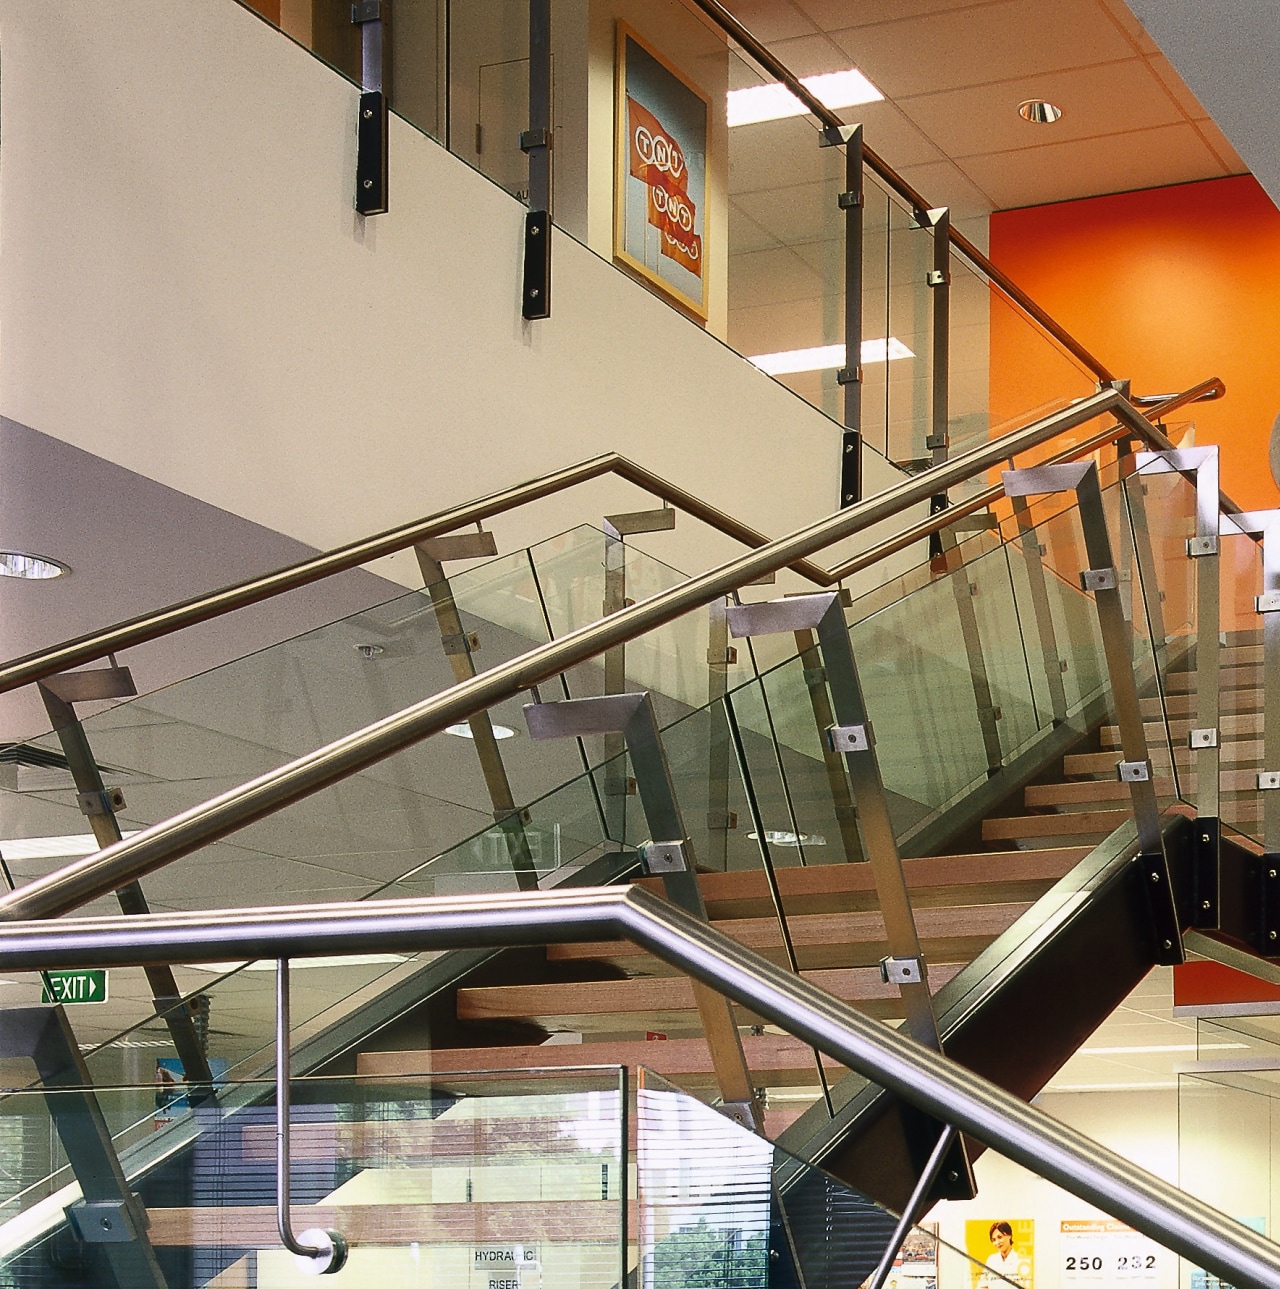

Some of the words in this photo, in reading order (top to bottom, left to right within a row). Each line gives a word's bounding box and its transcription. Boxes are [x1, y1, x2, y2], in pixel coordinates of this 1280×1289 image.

[50, 976, 87, 1000] EXIT
[475, 1251, 534, 1261] HYDRAIC
[1066, 1257, 1103, 1270] 250
[1118, 1256, 1156, 1270] 232
[489, 1280, 519, 1289] RISER
